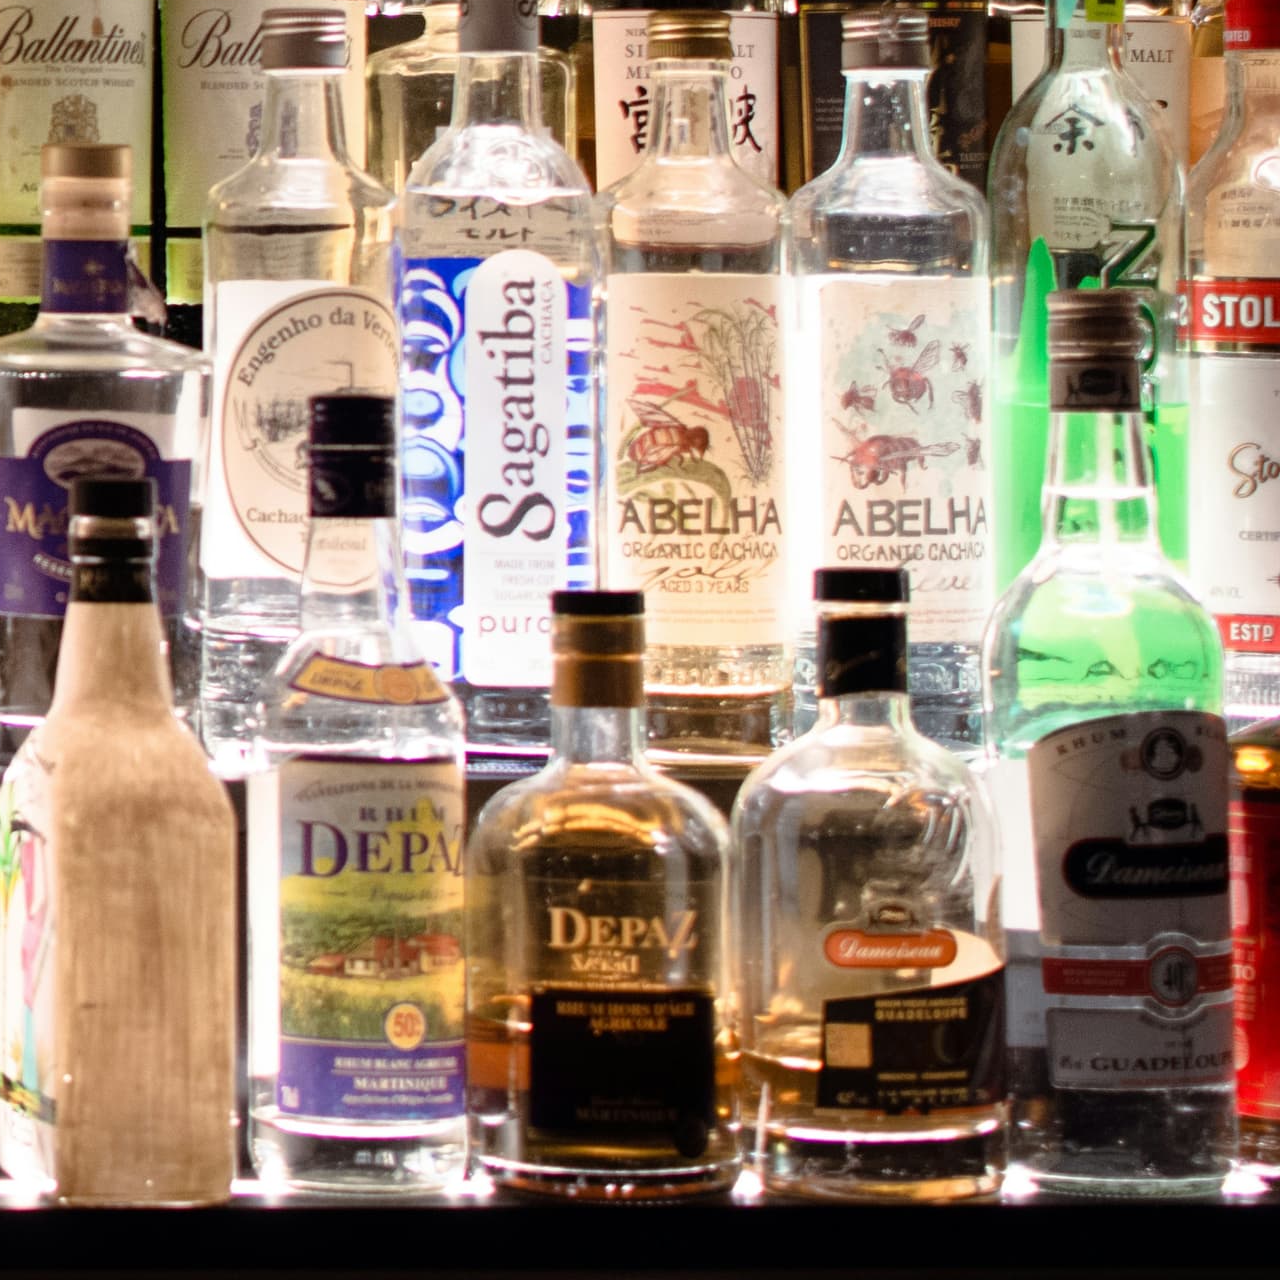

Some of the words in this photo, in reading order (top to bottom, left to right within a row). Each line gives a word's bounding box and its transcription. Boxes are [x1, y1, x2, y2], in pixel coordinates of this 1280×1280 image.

[1131, 48, 1174, 64] MALT
[541, 279, 555, 364] CACHAÇA
[237, 313, 321, 388] Engenho
[328, 306, 356, 328] da
[478, 275, 557, 543] Sagatiba
[618, 497, 783, 538] ABELHA
[832, 498, 987, 538] ABELHA
[622, 542, 706, 562] ORGANIC
[837, 542, 925, 562] ORGANIC
[659, 580, 692, 594] AGED
[707, 579, 749, 594] YEARS
[548, 906, 698, 956] DEPAZ
[354, 1075, 448, 1092] MARTINIQUE
